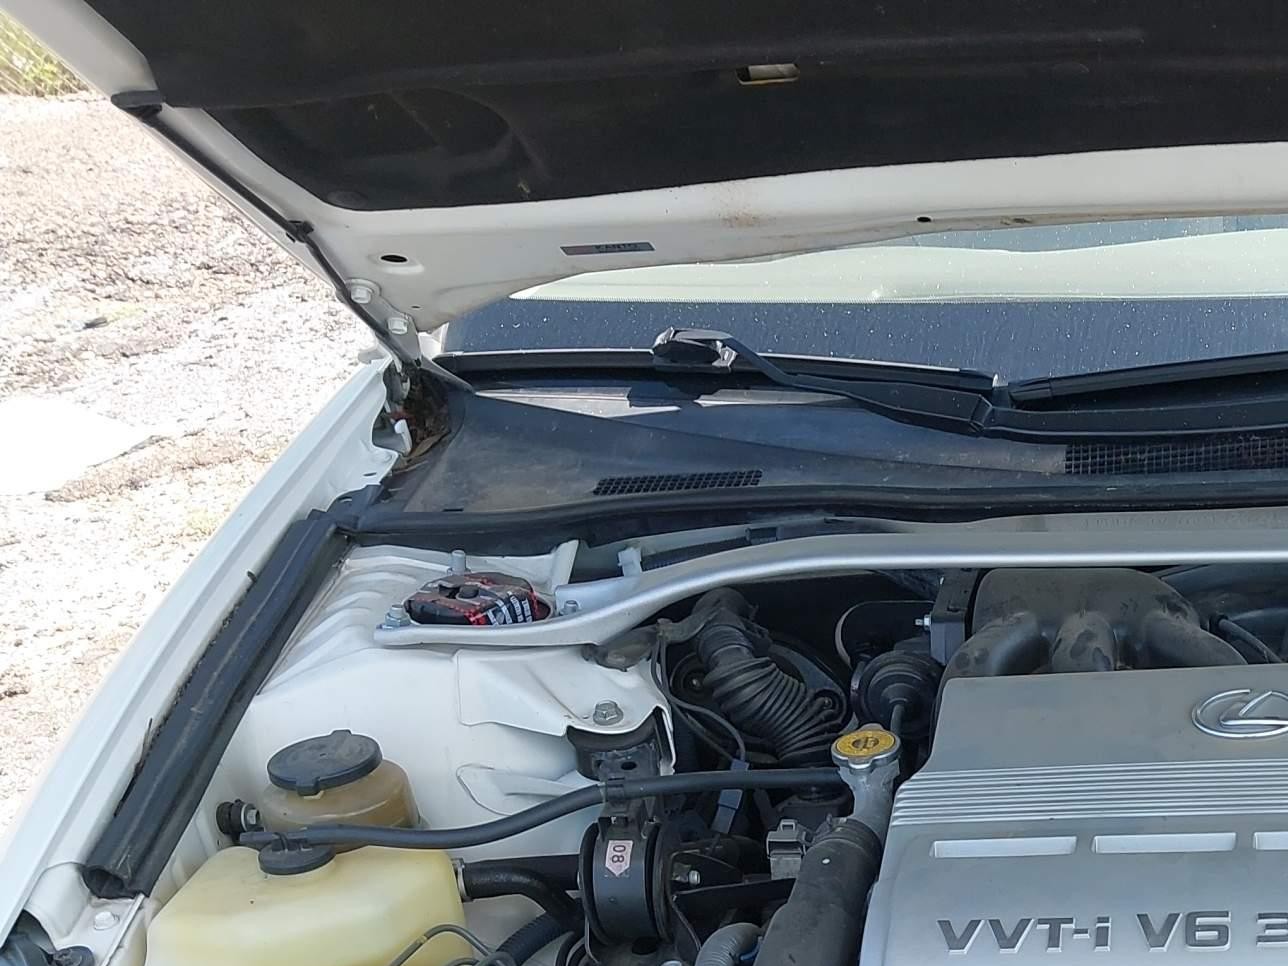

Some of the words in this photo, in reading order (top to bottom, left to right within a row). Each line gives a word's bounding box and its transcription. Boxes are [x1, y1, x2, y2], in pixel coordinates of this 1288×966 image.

[611, 844, 626, 864] 08
[937, 916, 1112, 955] VVT-i
[1137, 910, 1232, 952] V6
